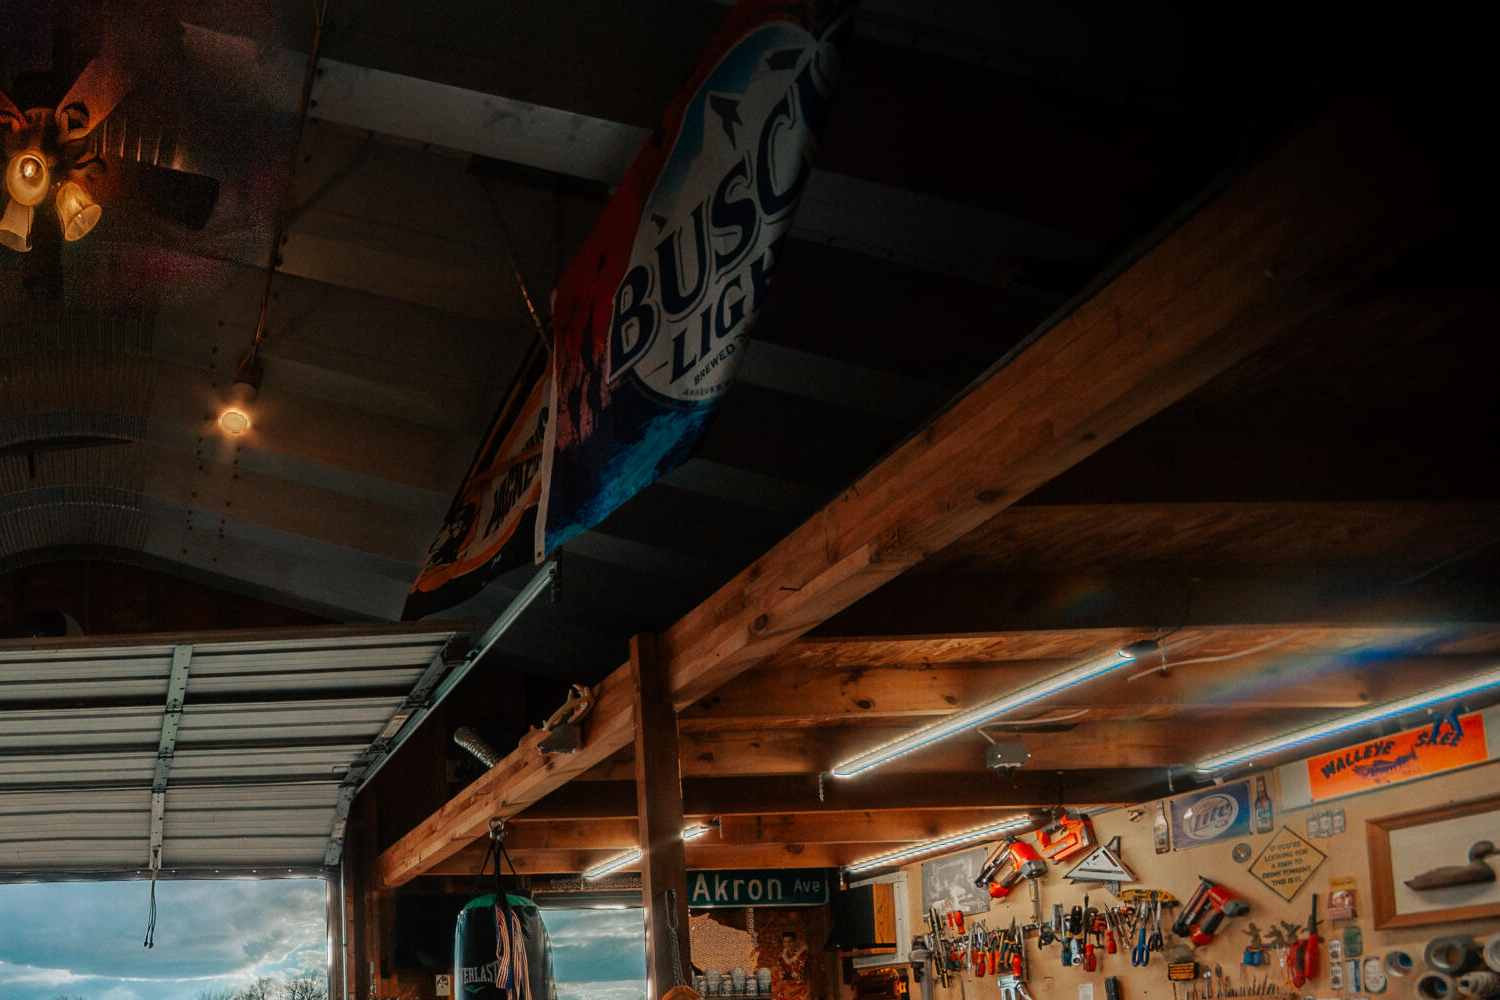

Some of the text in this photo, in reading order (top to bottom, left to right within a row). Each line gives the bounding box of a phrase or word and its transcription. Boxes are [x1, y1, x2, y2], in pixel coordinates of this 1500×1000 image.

[607, 88, 811, 380] BUSC
[670, 233, 787, 385] LIGH
[1321, 740, 1396, 779] WALLEYE
[692, 872, 821, 902] Akron Ave
